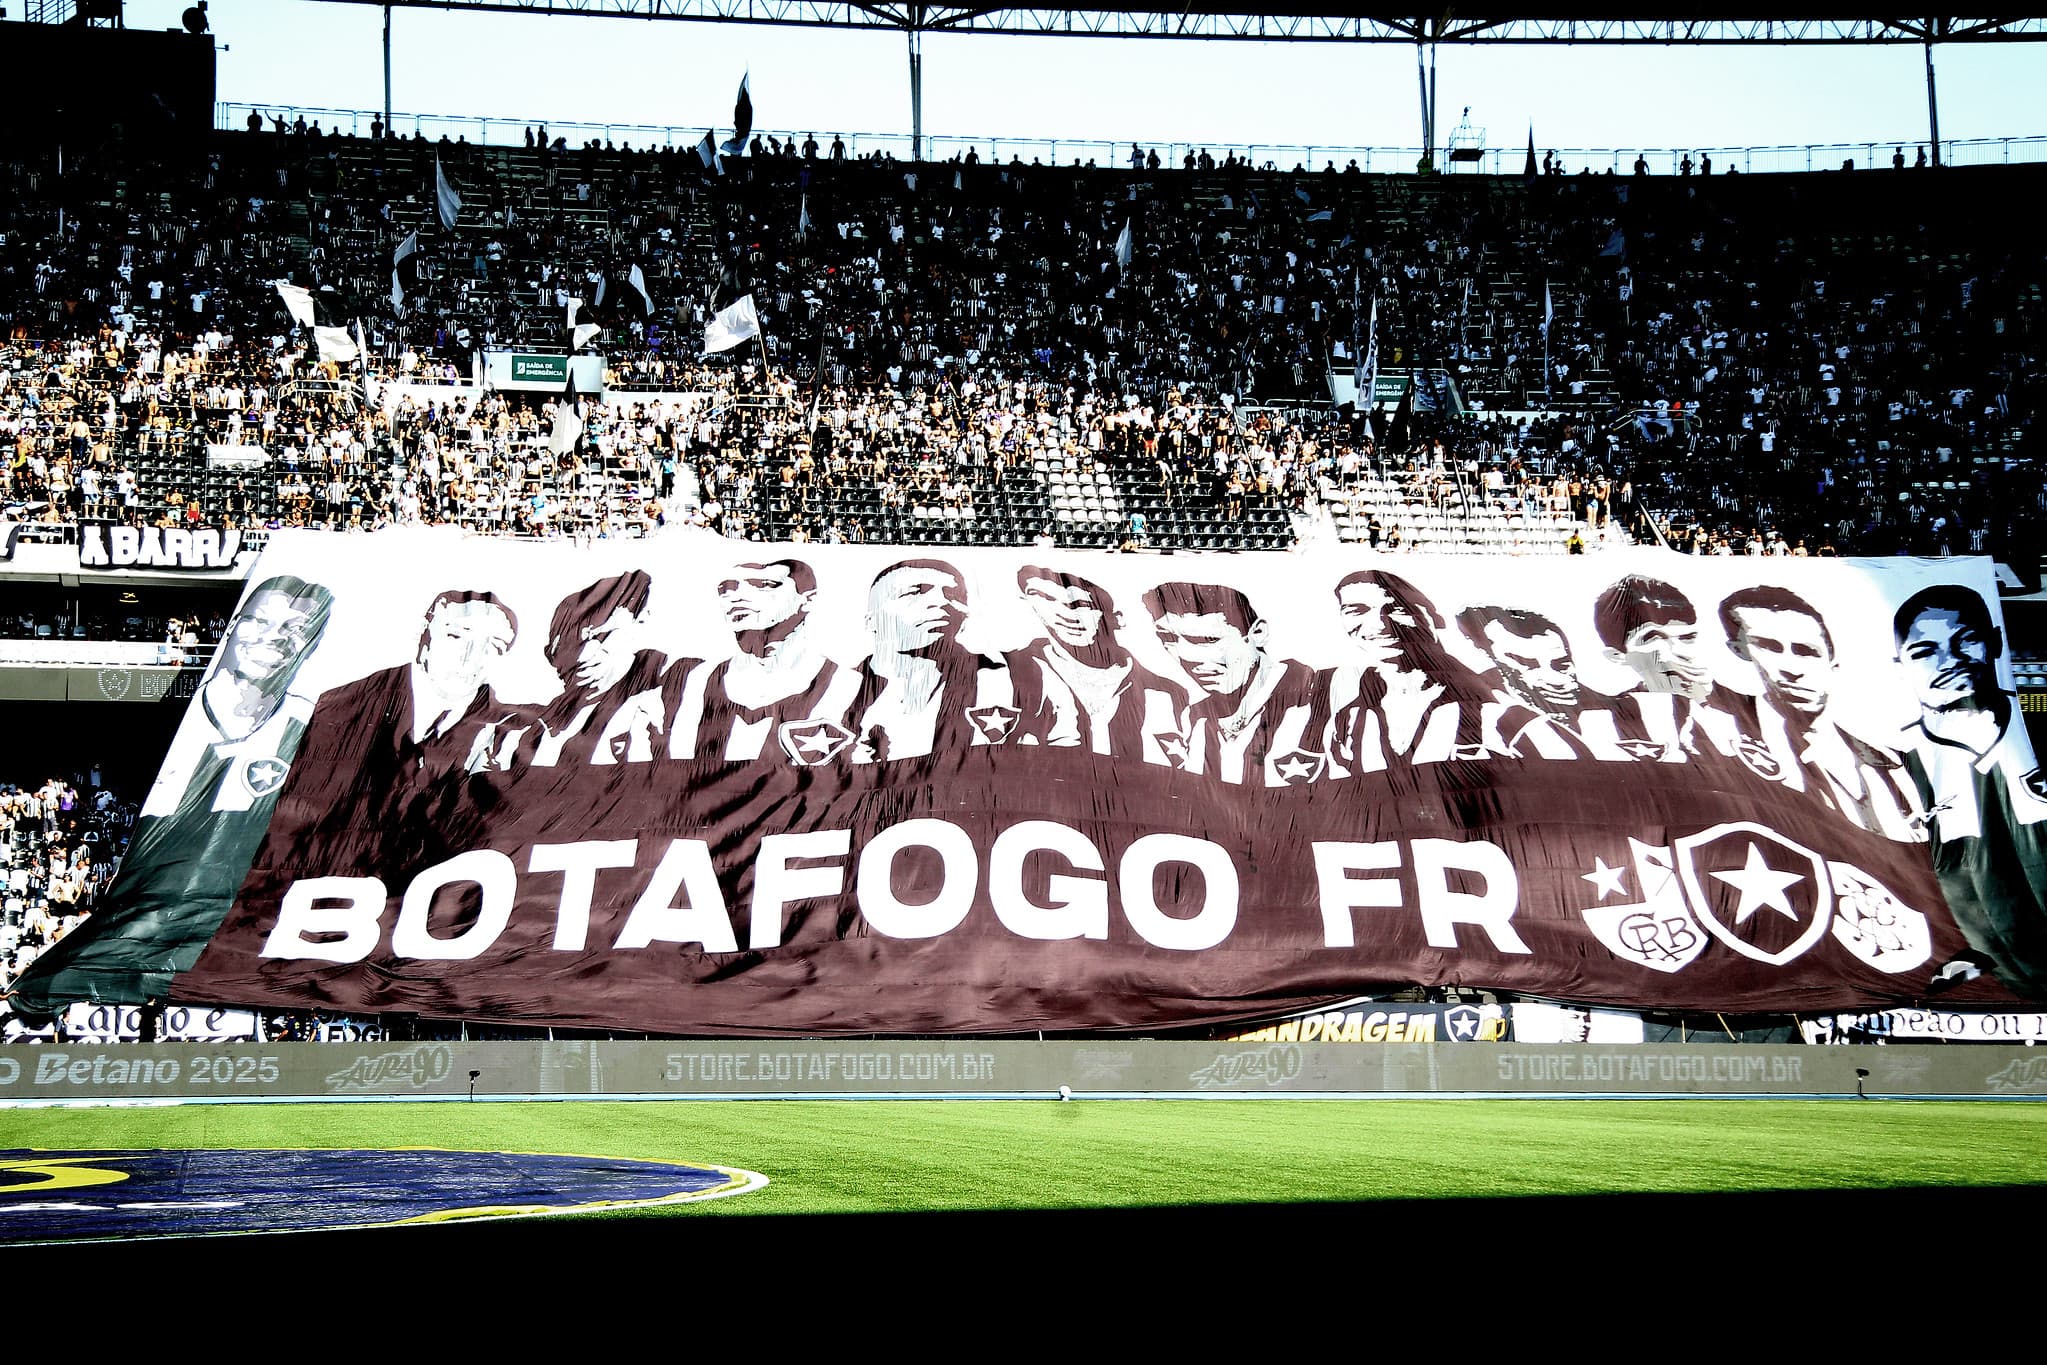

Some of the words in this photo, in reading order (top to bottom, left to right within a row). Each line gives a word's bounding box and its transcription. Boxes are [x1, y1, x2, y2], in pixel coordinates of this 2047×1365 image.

[1375, 382, 1393, 390] SAÍDA
[80, 525, 110, 566] A
[258, 817, 1239, 964] BOTAFOGO
[1312, 837, 1532, 954] FR
[34, 1053, 180, 1085] Betano
[189, 1056, 279, 1083] 2025
[665, 1052, 996, 1081] STORE.BOTAFOGO.COM.BR
[1497, 1054, 1803, 1083] STORE.BOTAFOGO.COM.BR
